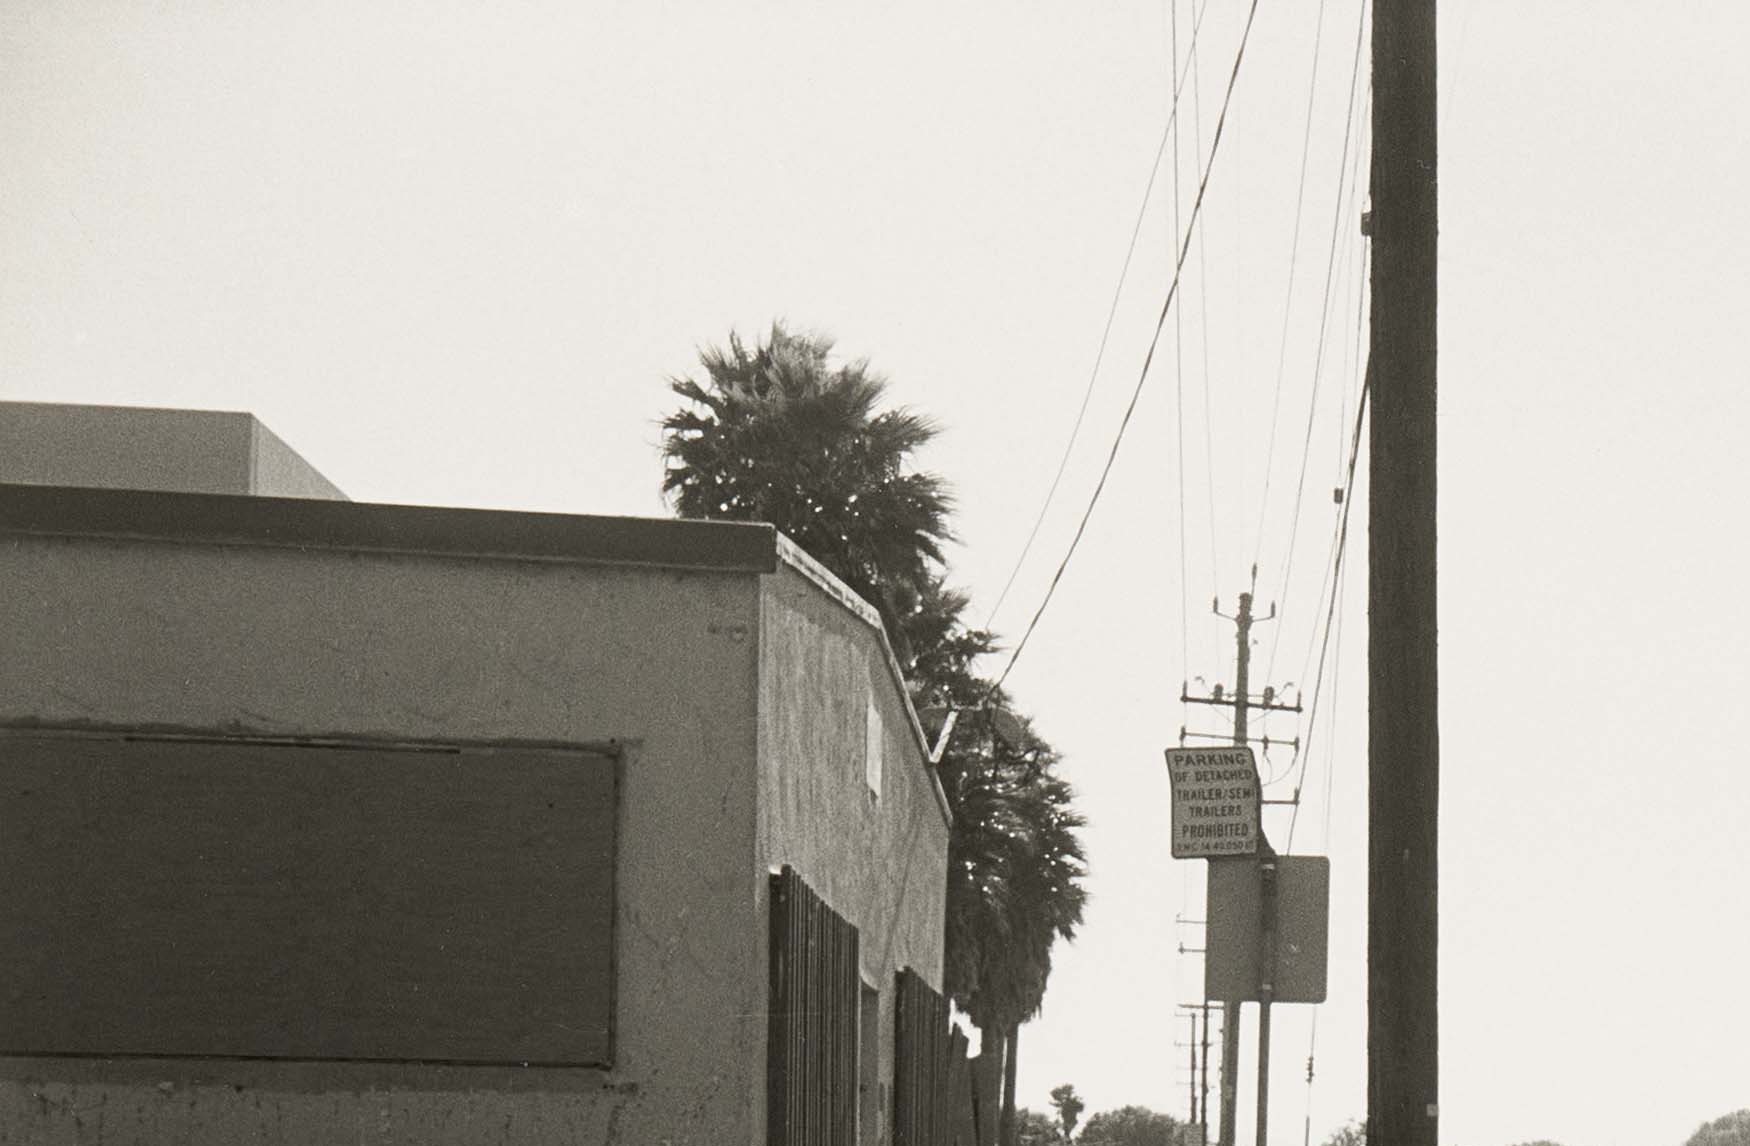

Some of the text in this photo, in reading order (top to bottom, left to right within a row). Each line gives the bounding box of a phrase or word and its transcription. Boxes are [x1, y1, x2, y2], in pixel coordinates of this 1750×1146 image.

[1174, 754, 1247, 766] PARKING
[1175, 770, 1253, 783] OF DETACHED
[1188, 805, 1242, 818] TRAILERS
[1182, 823, 1249, 839] PROHIBITED
